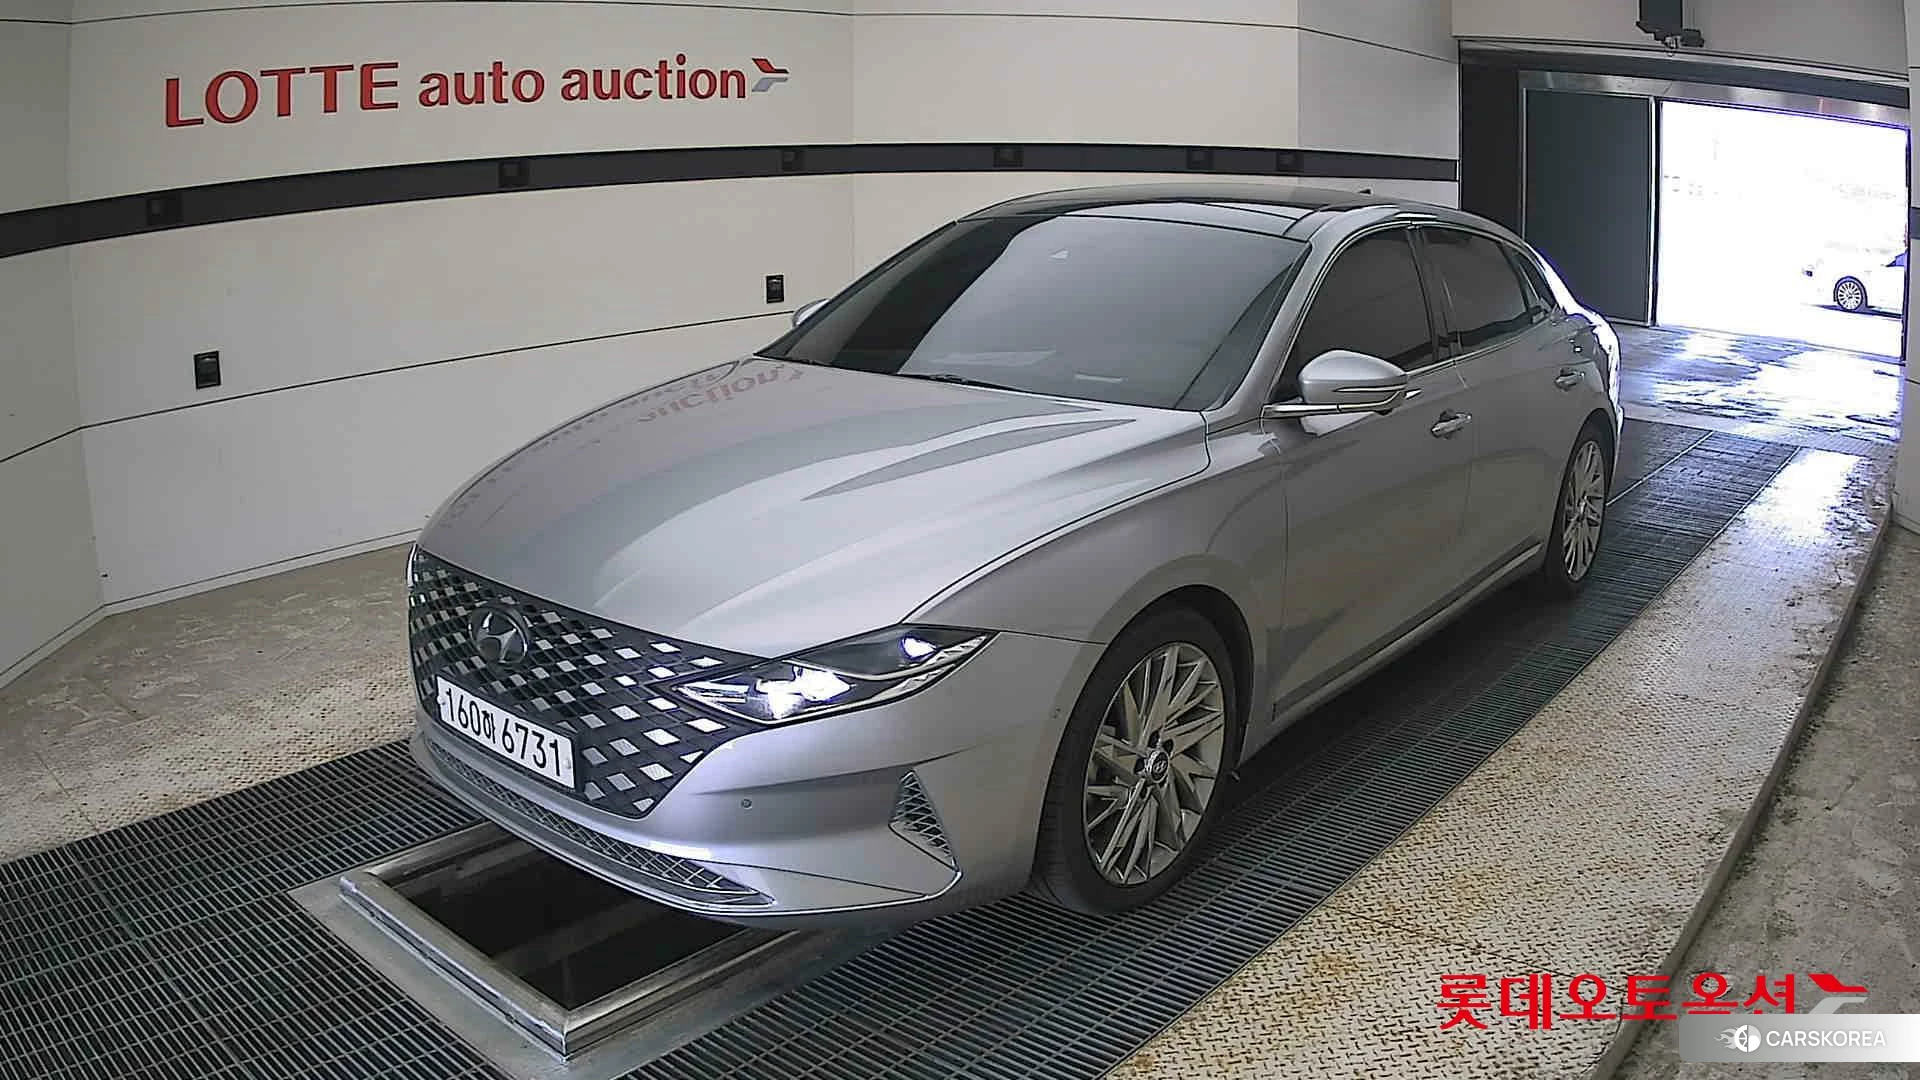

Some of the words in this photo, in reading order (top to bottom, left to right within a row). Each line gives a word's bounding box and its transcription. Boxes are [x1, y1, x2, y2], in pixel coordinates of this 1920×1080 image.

[165, 61, 399, 127] LOTTE
[419, 60, 545, 107] auto
[560, 53, 747, 101] auction
[446, 687, 496, 744] 160하
[501, 718, 561, 777] 6731
